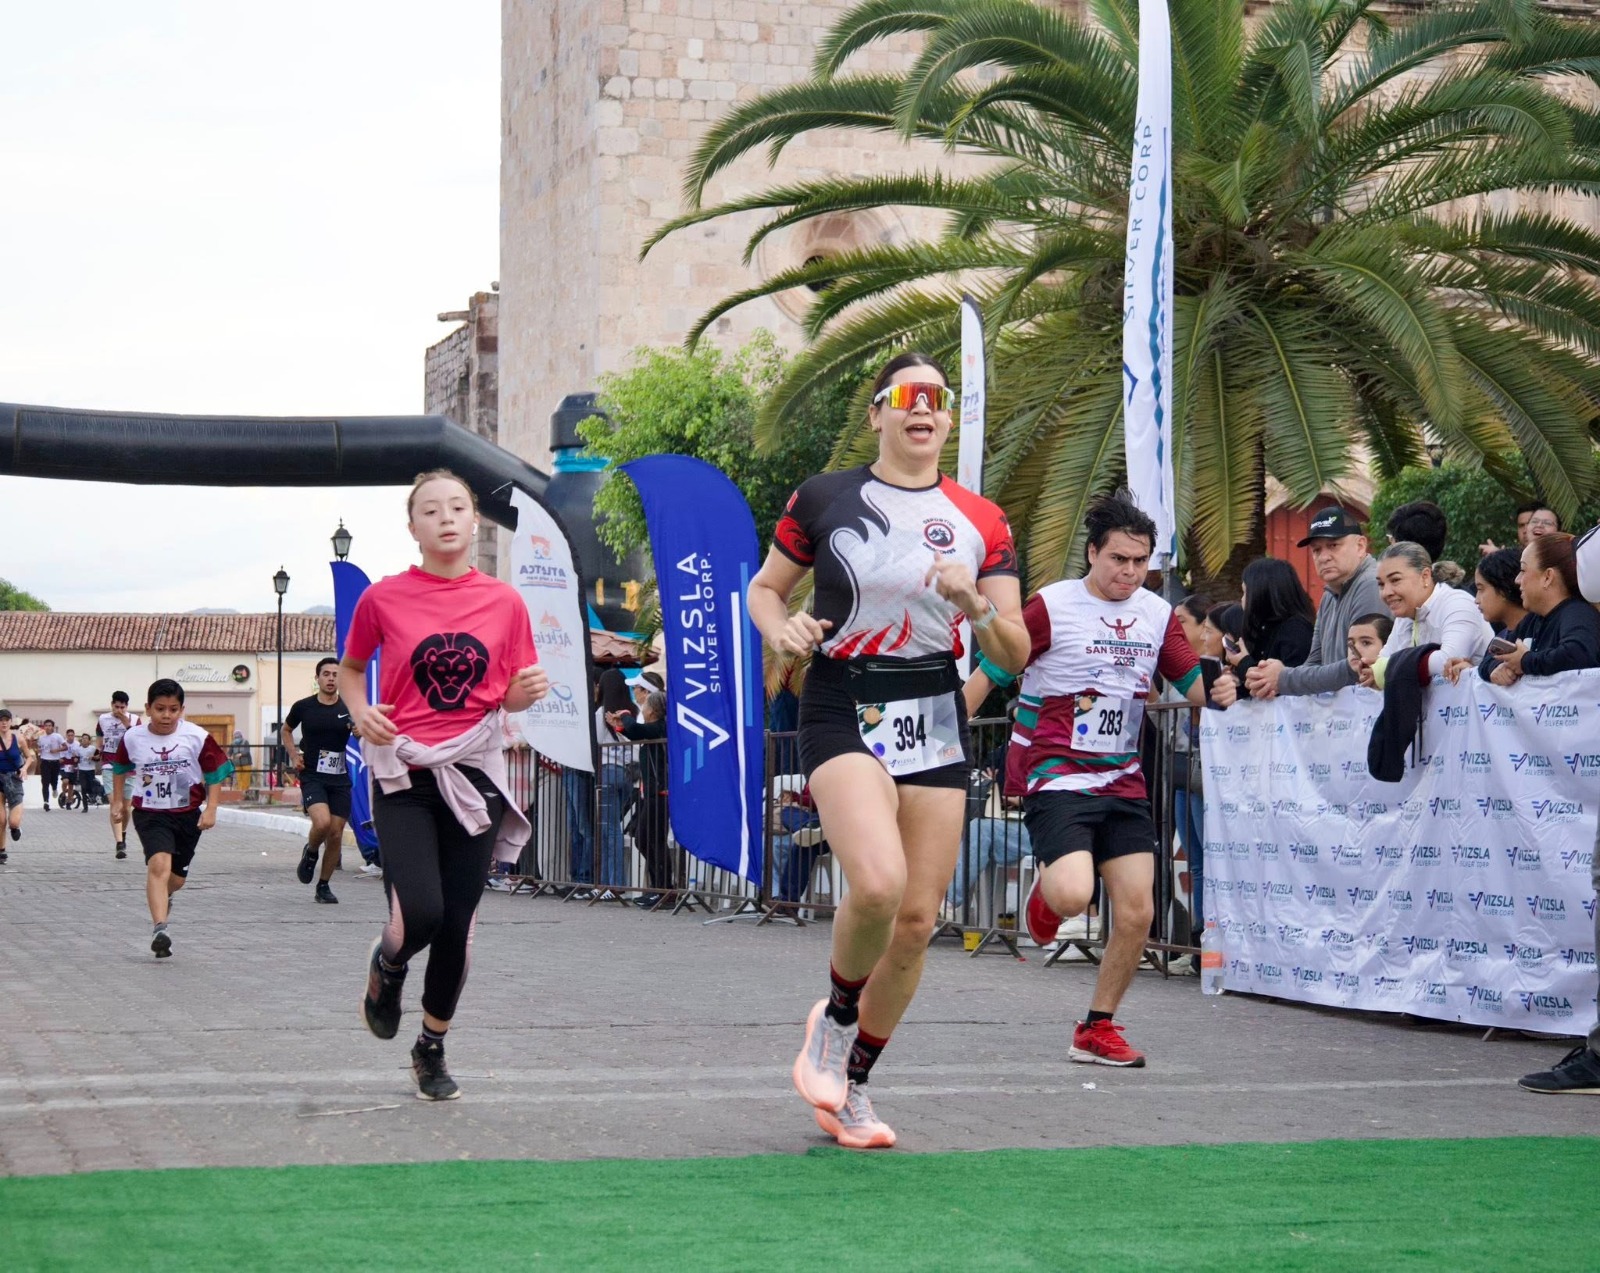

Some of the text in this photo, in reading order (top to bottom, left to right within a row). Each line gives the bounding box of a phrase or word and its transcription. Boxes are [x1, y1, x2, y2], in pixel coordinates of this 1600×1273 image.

[922, 541, 956, 554] DRAONES
[676, 552, 708, 700] VIZSLA
[700, 552, 721, 693] SILVER CORP.
[1085, 646, 1108, 654] SAN
[1546, 705, 1579, 718] VIZSLA
[1098, 709, 1123, 736] 283
[1544, 719, 1563, 727] SILVER
[893, 714, 926, 752] 394
[1527, 755, 1552, 768] VIZSLA
[155, 782, 172, 798] 154
[1366, 802, 1388, 814] VIZSLA
[1492, 799, 1513, 812] VIZSLA
[1548, 802, 1583, 815] VIZSLA
[1299, 844, 1318, 856] VIZSLA
[1416, 846, 1441, 858] VIZSLA
[1460, 847, 1490, 860] VIZSLA
[1517, 849, 1541, 862] VIZSLA
[1576, 852, 1592, 865] VIZ
[1270, 884, 1293, 895] VIZSLA
[1315, 886, 1336, 898] VIZSLA
[1484, 895, 1515, 908] VIZSLA
[1538, 898, 1566, 912] VIZSLA
[1415, 938, 1439, 950] VIZSLA
[1454, 940, 1488, 955] VIZSLA
[1575, 950, 1596, 964] VIZS
[1262, 965, 1282, 976] VIZSLA
[1533, 996, 1572, 1009] VIZSLA
